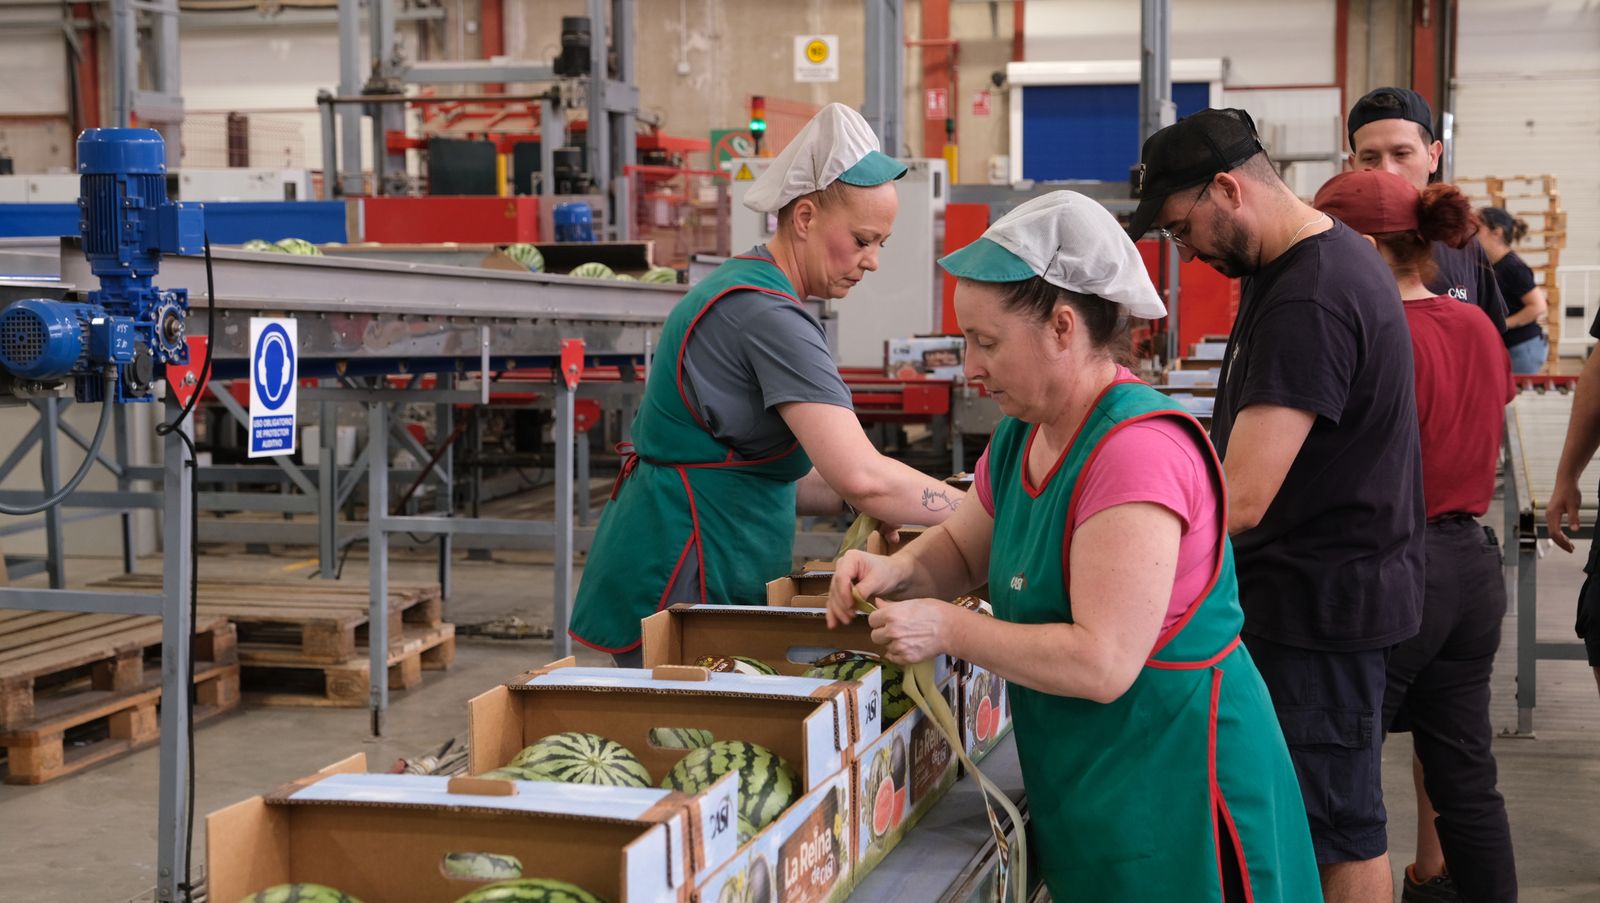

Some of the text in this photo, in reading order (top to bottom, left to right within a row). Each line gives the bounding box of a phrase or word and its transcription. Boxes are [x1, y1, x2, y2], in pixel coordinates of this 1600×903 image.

[1448, 288, 1467, 300] CASI
[263, 417, 293, 427] OBLIGATORIO
[263, 428, 289, 437] PROTECTOR
[785, 824, 832, 890] La Reina
